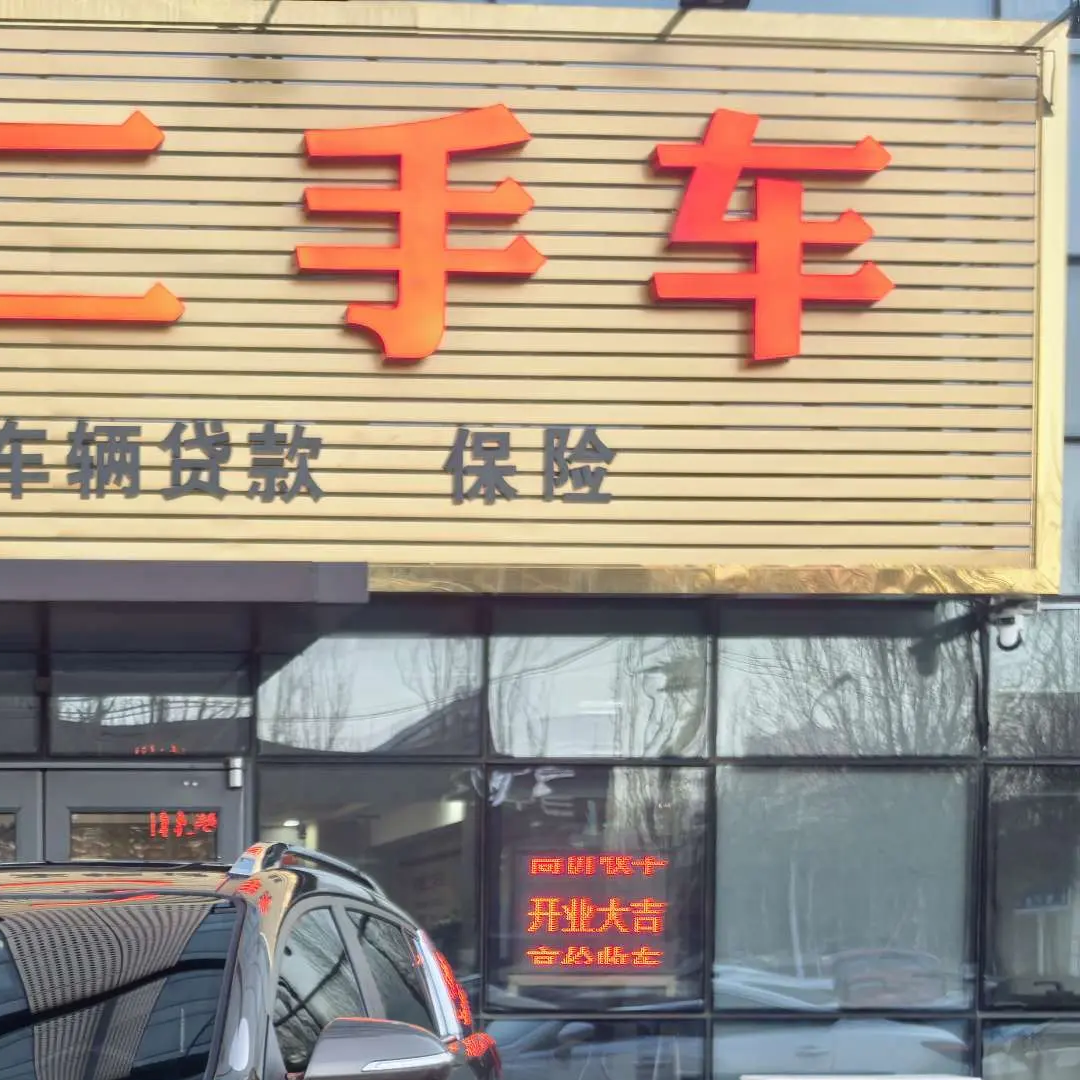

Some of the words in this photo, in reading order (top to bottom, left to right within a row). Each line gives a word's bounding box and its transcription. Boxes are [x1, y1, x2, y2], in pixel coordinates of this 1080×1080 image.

[443, 426, 616, 505] 保险
[526, 896, 668, 934] 开业大吉
